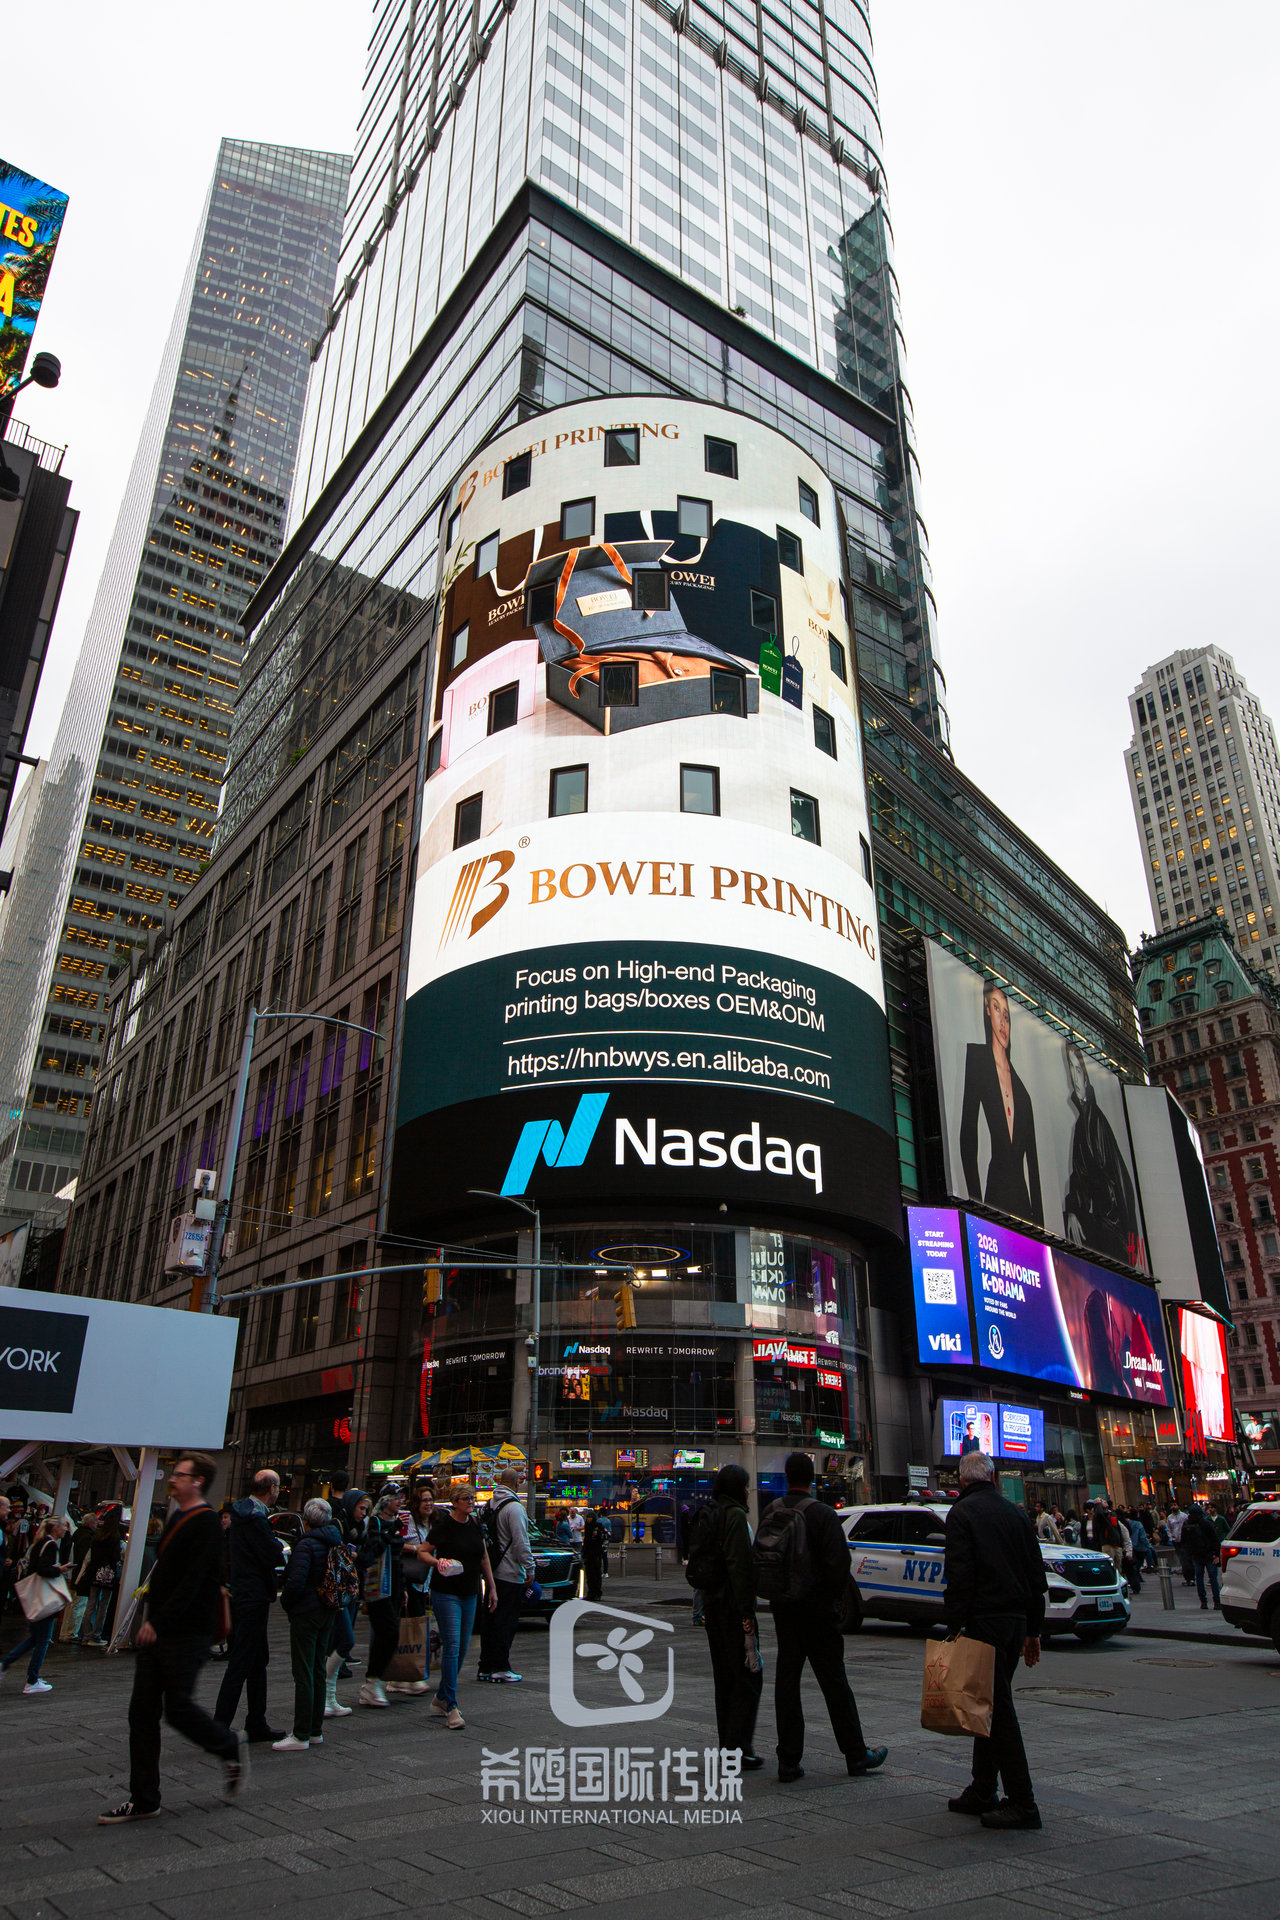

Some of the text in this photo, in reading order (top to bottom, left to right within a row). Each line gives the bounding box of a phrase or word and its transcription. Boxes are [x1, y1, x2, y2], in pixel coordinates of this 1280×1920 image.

[483, 422, 680, 487] BOEI PRINNG
[670, 570, 716, 587] OWEI
[488, 594, 525, 622] BOW
[808, 617, 830, 642] BOW
[528, 861, 877, 962] BOWEI PRINTING
[515, 959, 816, 1006] Focus on High-end Packaging
[505, 989, 826, 1032] printing bags/boxes OEM&ODM
[507, 1047, 831, 1090] https://hnbwys.en.alibaba.com
[614, 1118, 824, 1195] Nasdaq
[917, 1240, 955, 1249] STREAMING
[926, 1250, 948, 1258] TODAY
[977, 1233, 999, 1254] 2026
[979, 1251, 1041, 1289] FAN FAVORITE
[981, 1272, 1026, 1303] K-DRAMA
[445, 1356, 468, 1366] REWRITE
[469, 1351, 506, 1362] TOMORROW
[578, 1344, 716, 1356] Nasdaq REWRITE TOMORROW
[1123, 1351, 1147, 1371] Dream
[1150, 1353, 1165, 1373] You
[623, 1406, 668, 1420] Nasdaq
